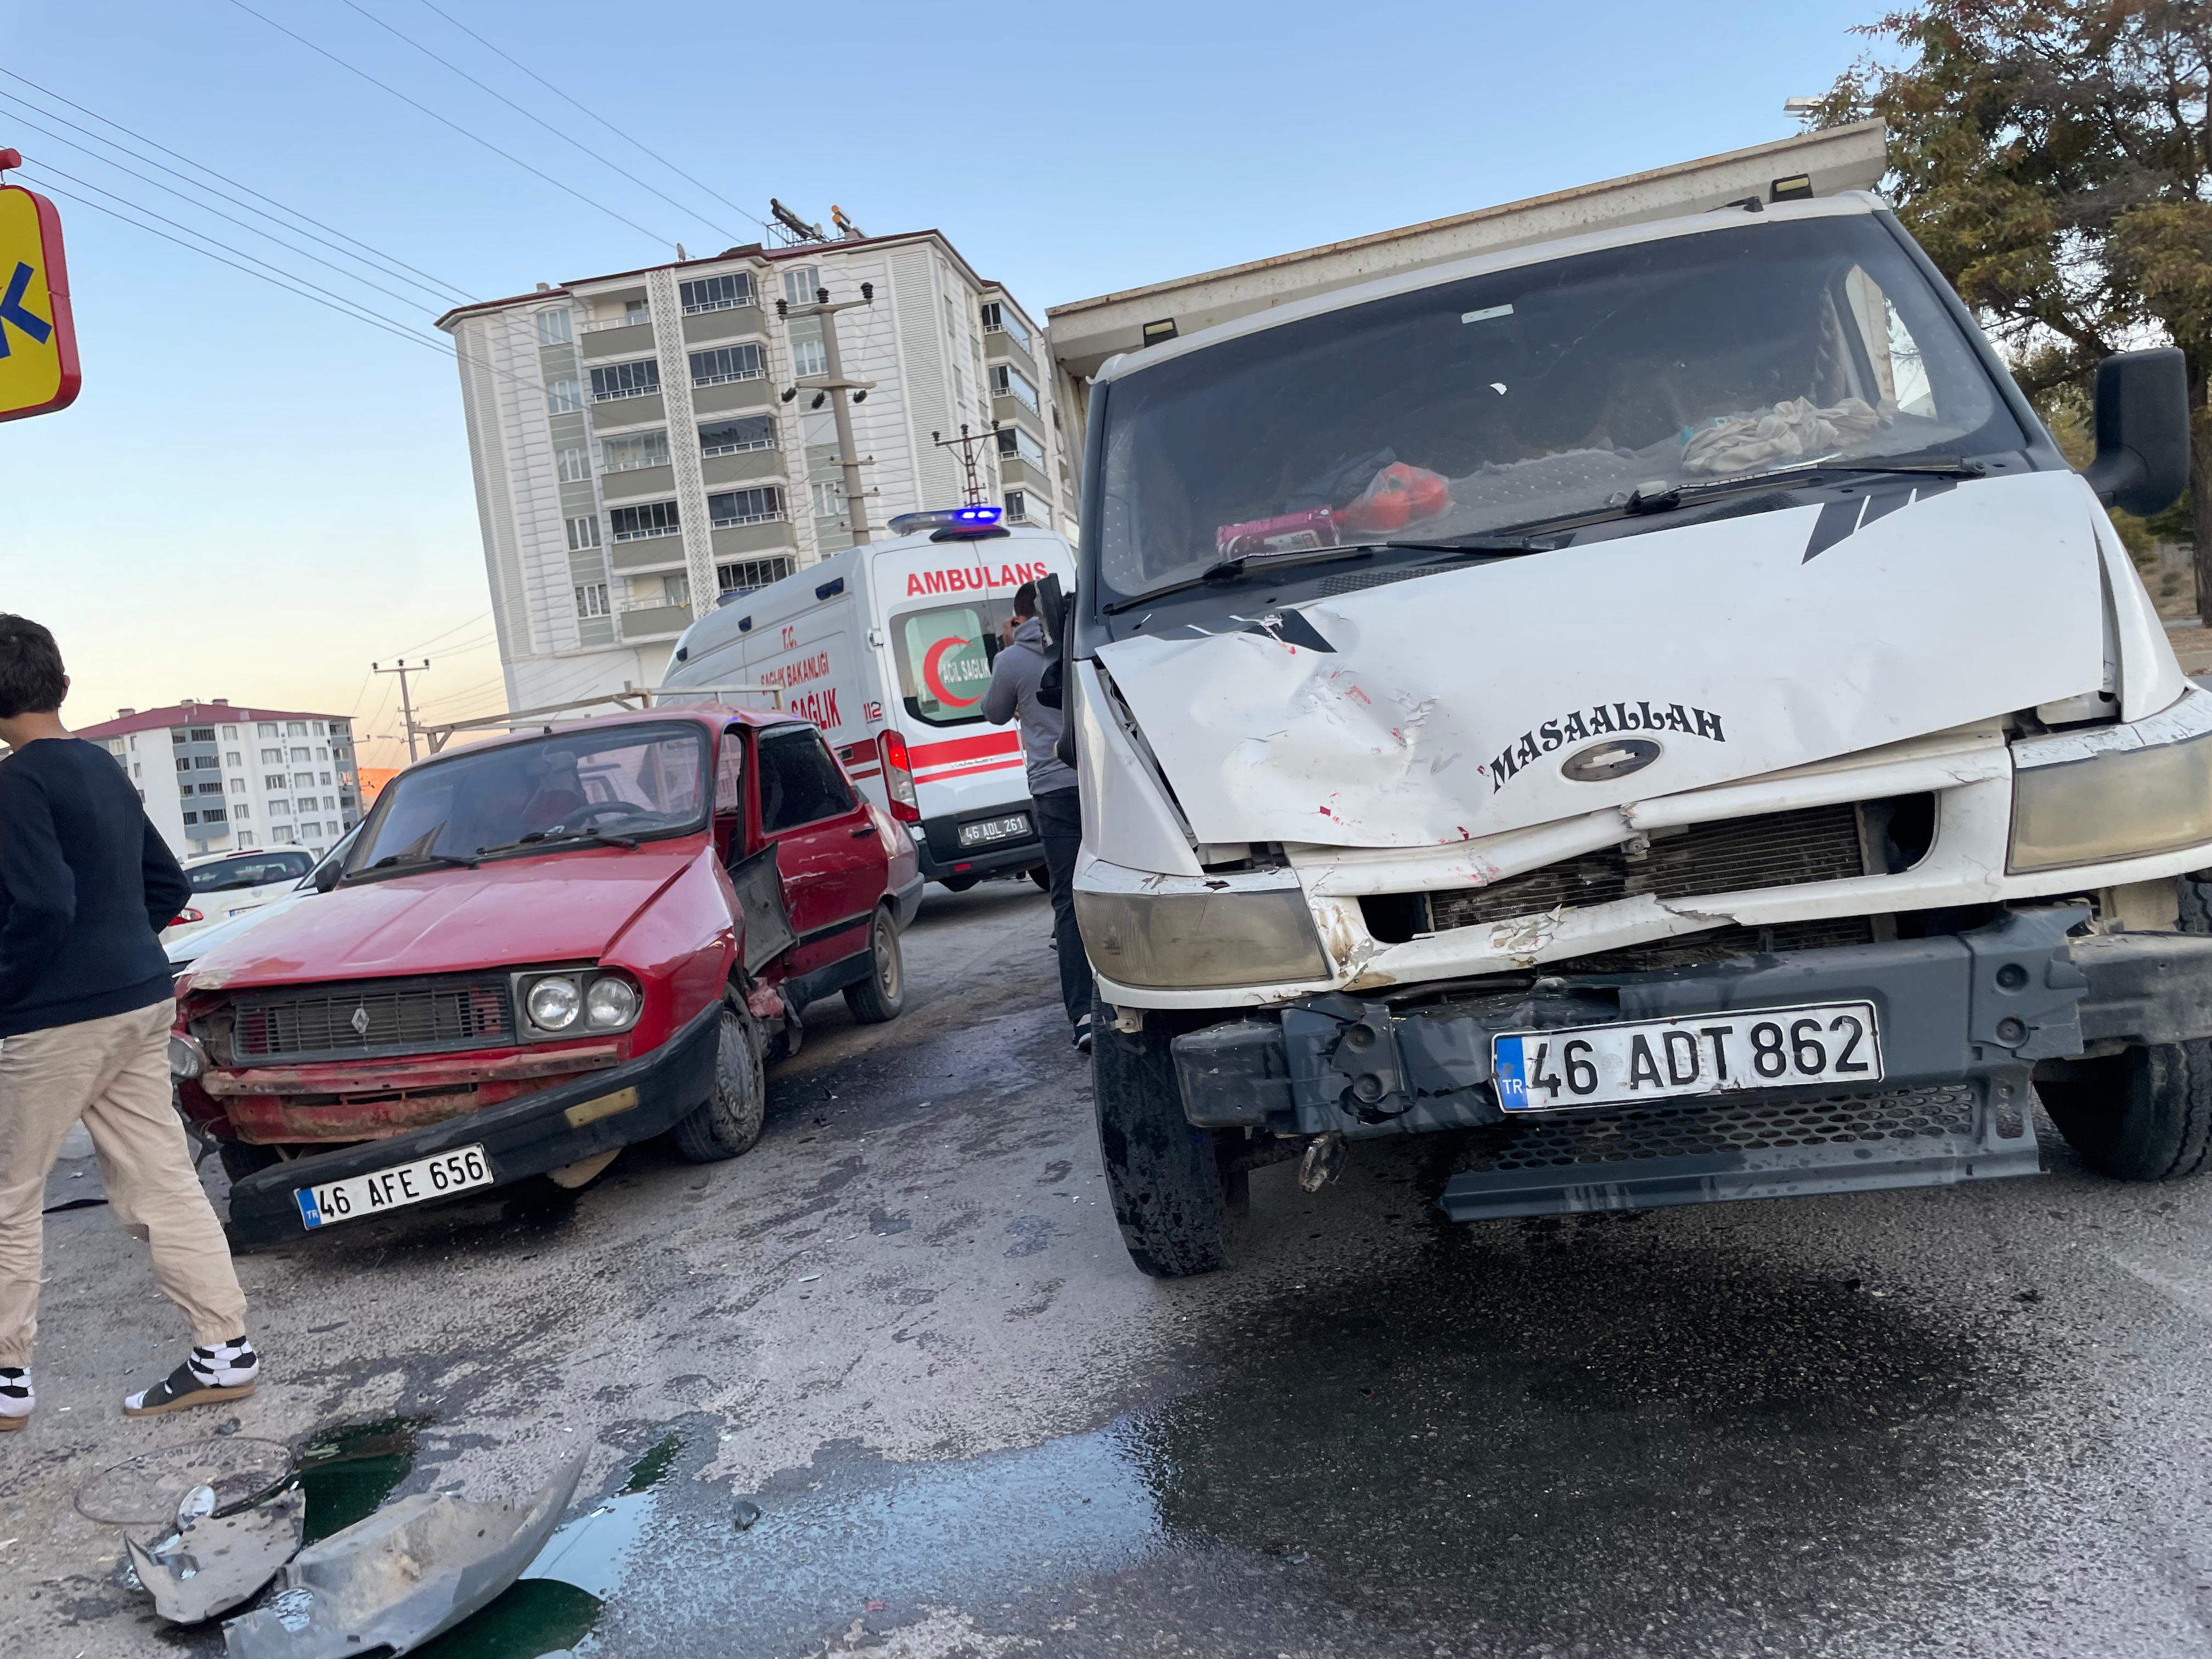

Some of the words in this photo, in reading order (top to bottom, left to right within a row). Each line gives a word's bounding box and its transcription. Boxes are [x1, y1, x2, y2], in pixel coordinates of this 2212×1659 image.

[907, 562, 1049, 596] AMBULANS
[782, 626, 797, 650] T.C.
[786, 650, 830, 687] BAKANLIĞI
[864, 701, 882, 720] 112
[1489, 701, 1726, 795] MASAALLAH
[966, 826, 980, 840] 46
[983, 822, 1002, 837] ADL
[1004, 817, 1024, 832] 261
[1502, 1078, 1523, 1094] TR
[1531, 1039, 1598, 1098] 46
[1630, 1025, 1733, 1091] ADT
[1750, 1015, 1869, 1079] 862
[307, 1209, 320, 1221] TR
[319, 1186, 351, 1217] 46
[368, 1169, 420, 1207] AFE
[429, 1152, 484, 1190] 656
